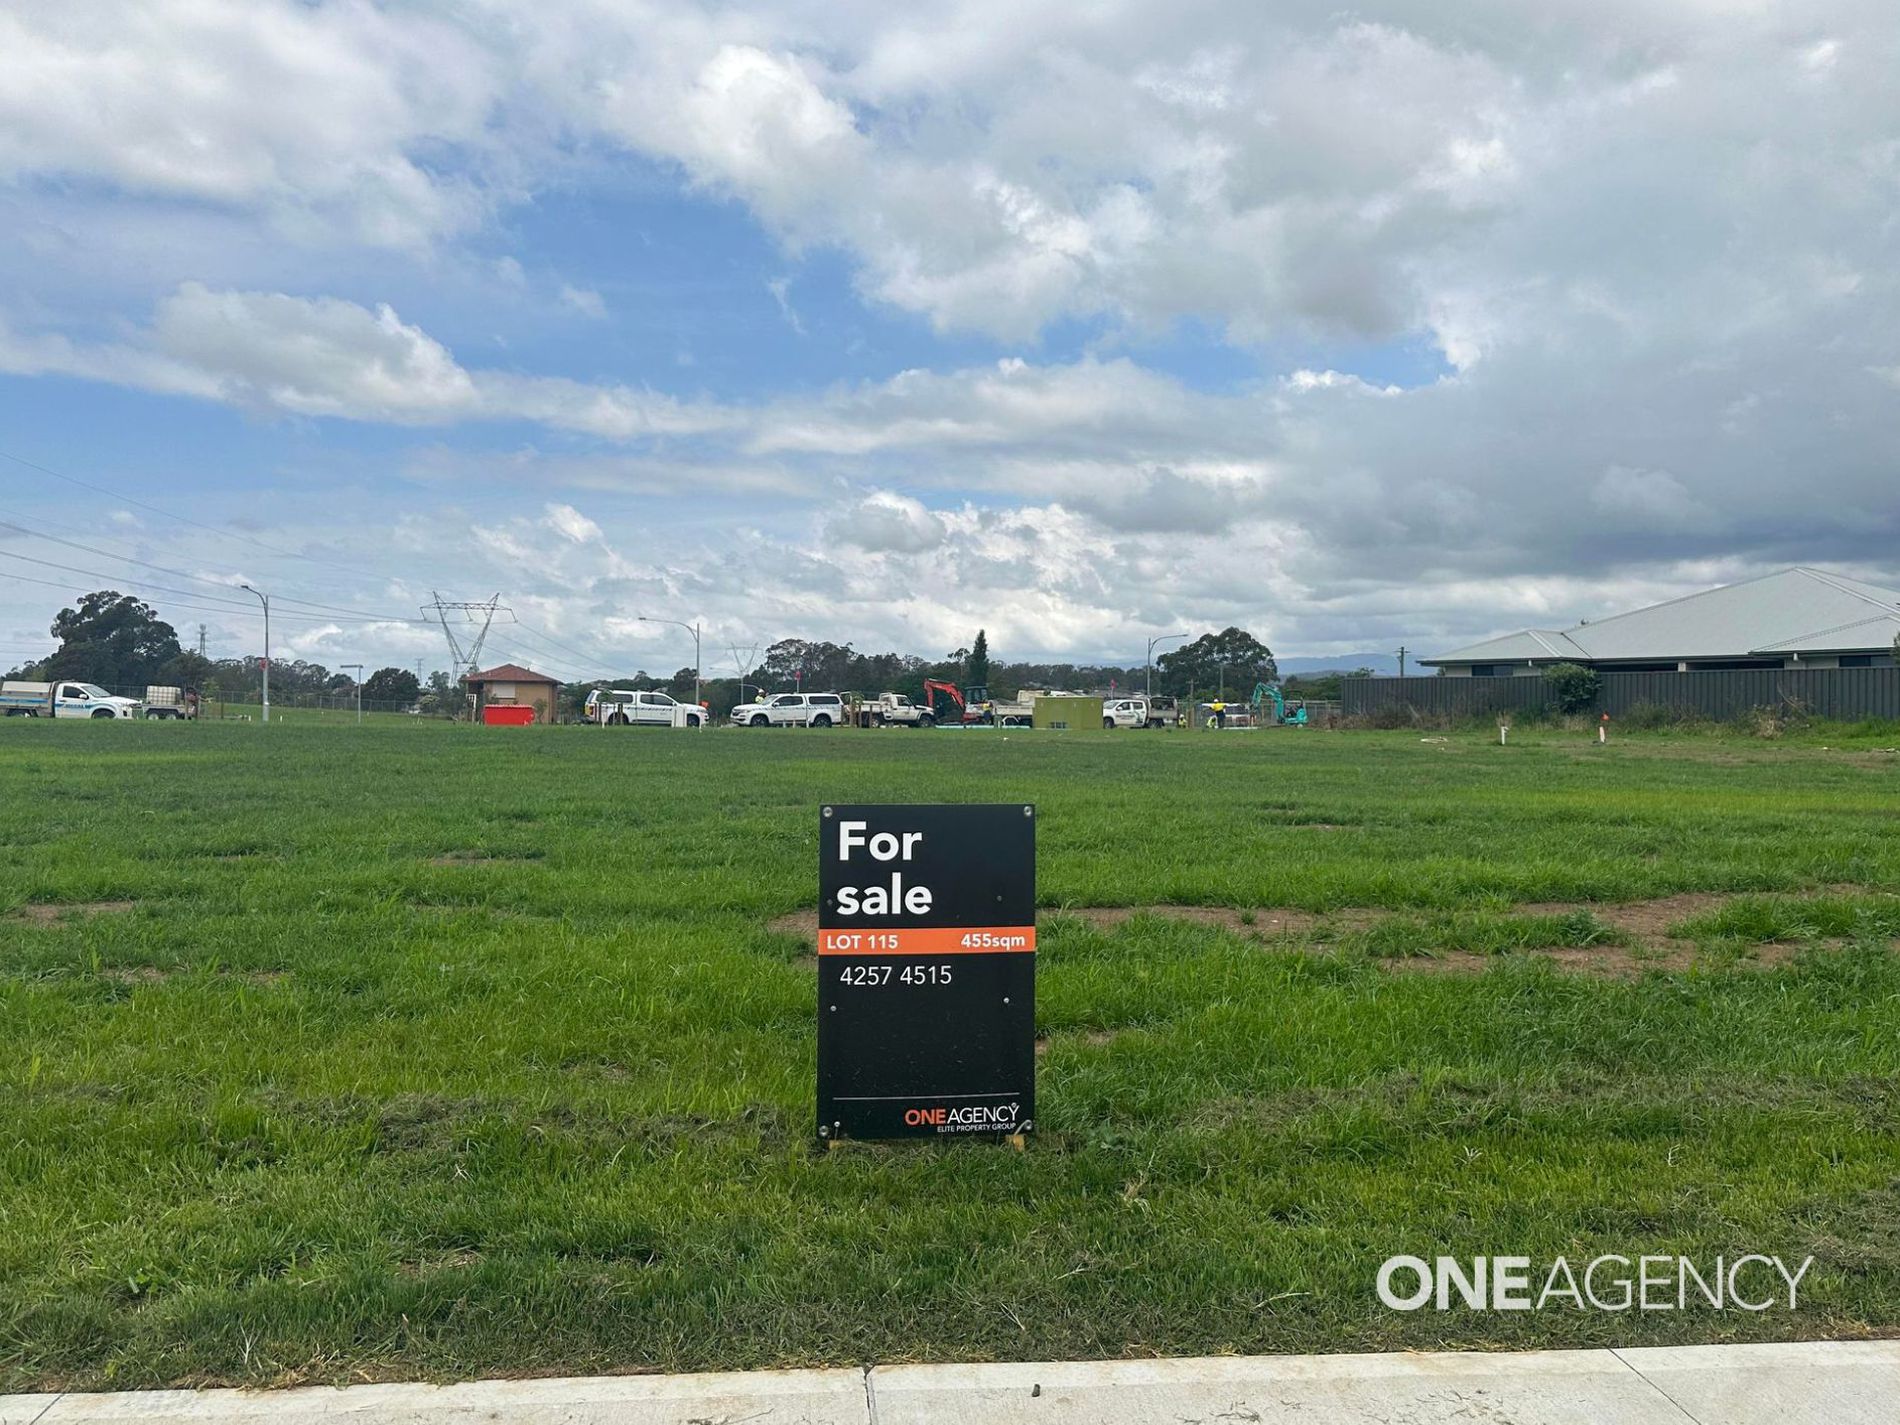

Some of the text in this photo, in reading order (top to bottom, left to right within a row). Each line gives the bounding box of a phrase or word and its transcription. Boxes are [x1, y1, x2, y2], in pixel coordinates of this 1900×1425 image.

[839, 821, 922, 861] For
[836, 872, 933, 915] sale
[826, 934, 898, 950] LOT 115
[960, 933, 1026, 950] 455sqm
[839, 965, 952, 985] 4257 4515
[937, 1122, 1017, 1133] ELITE PROPERTY GROUP
